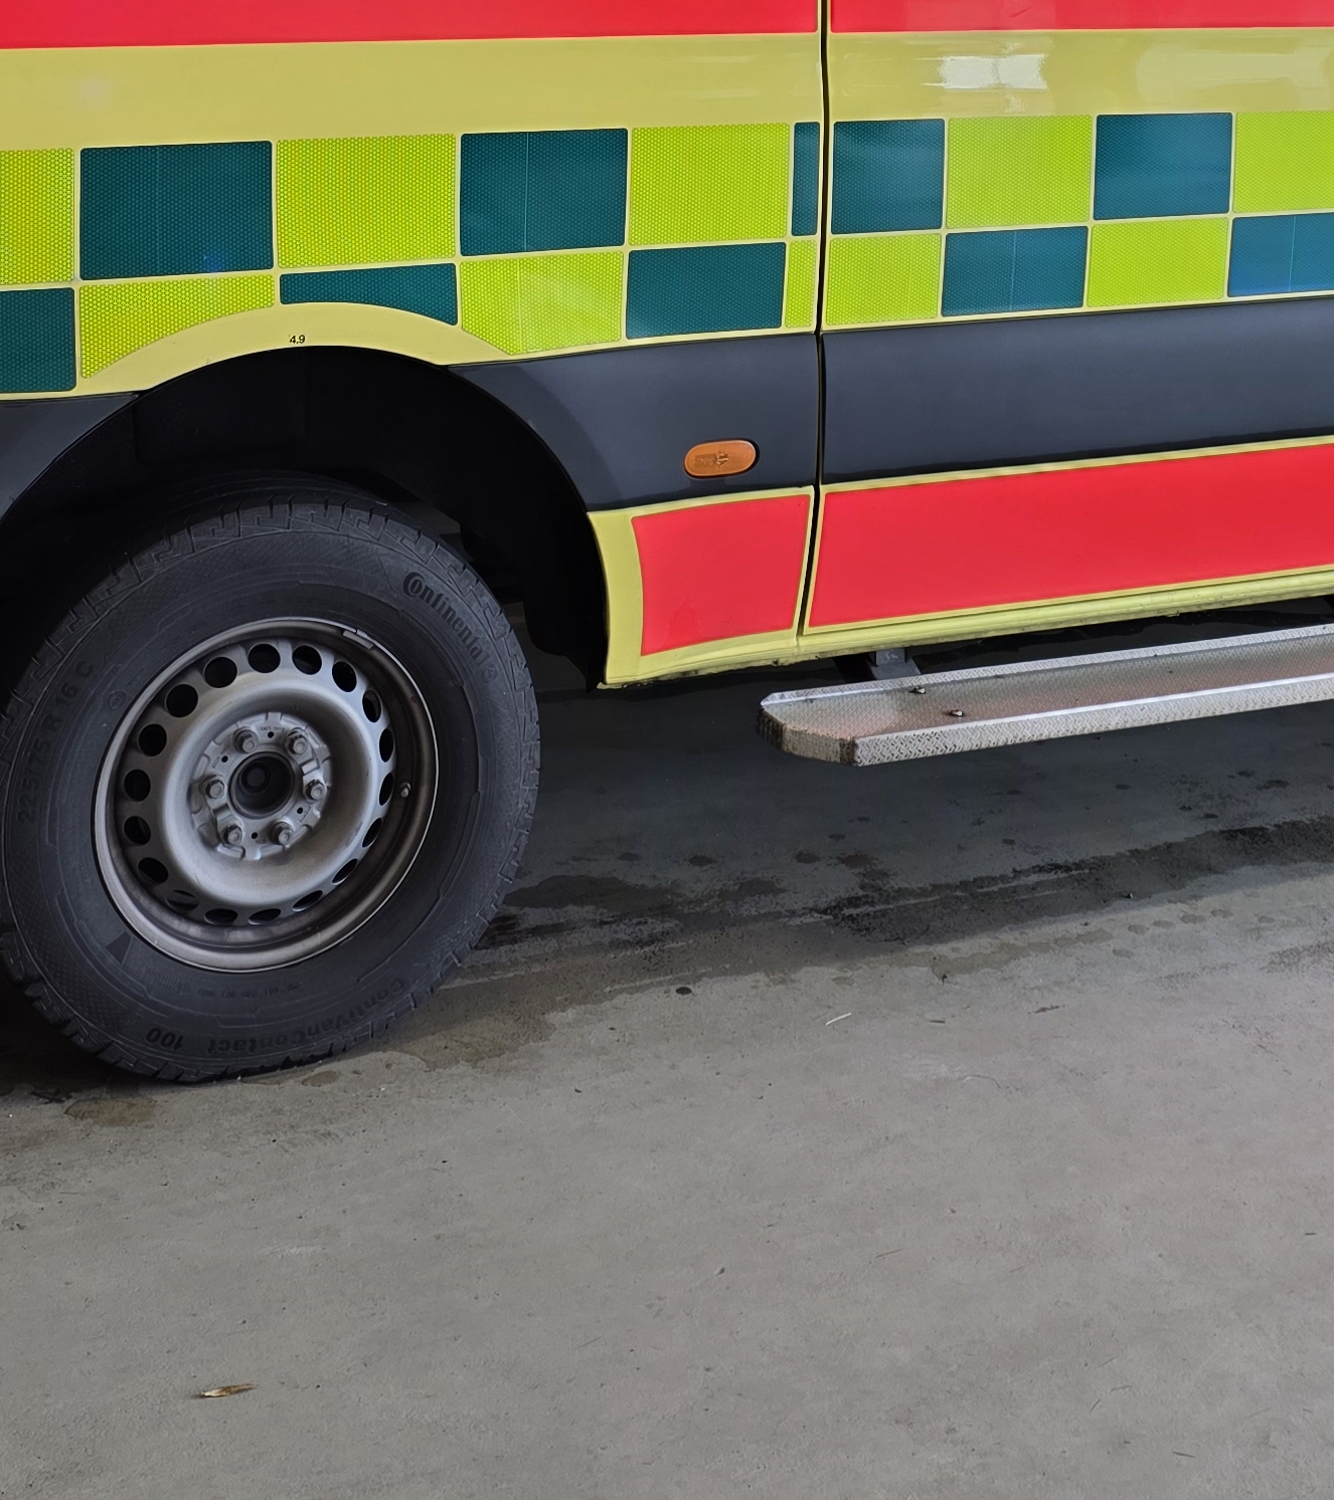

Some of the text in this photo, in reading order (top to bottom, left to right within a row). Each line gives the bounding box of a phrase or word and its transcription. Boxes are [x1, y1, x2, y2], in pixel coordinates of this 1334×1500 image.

[402, 571, 491, 668] Continental
[15, 737, 52, 825] 225/75
[41, 713, 63, 734] R
[54, 682, 79, 708] 16
[145, 1027, 186, 1051] 100
